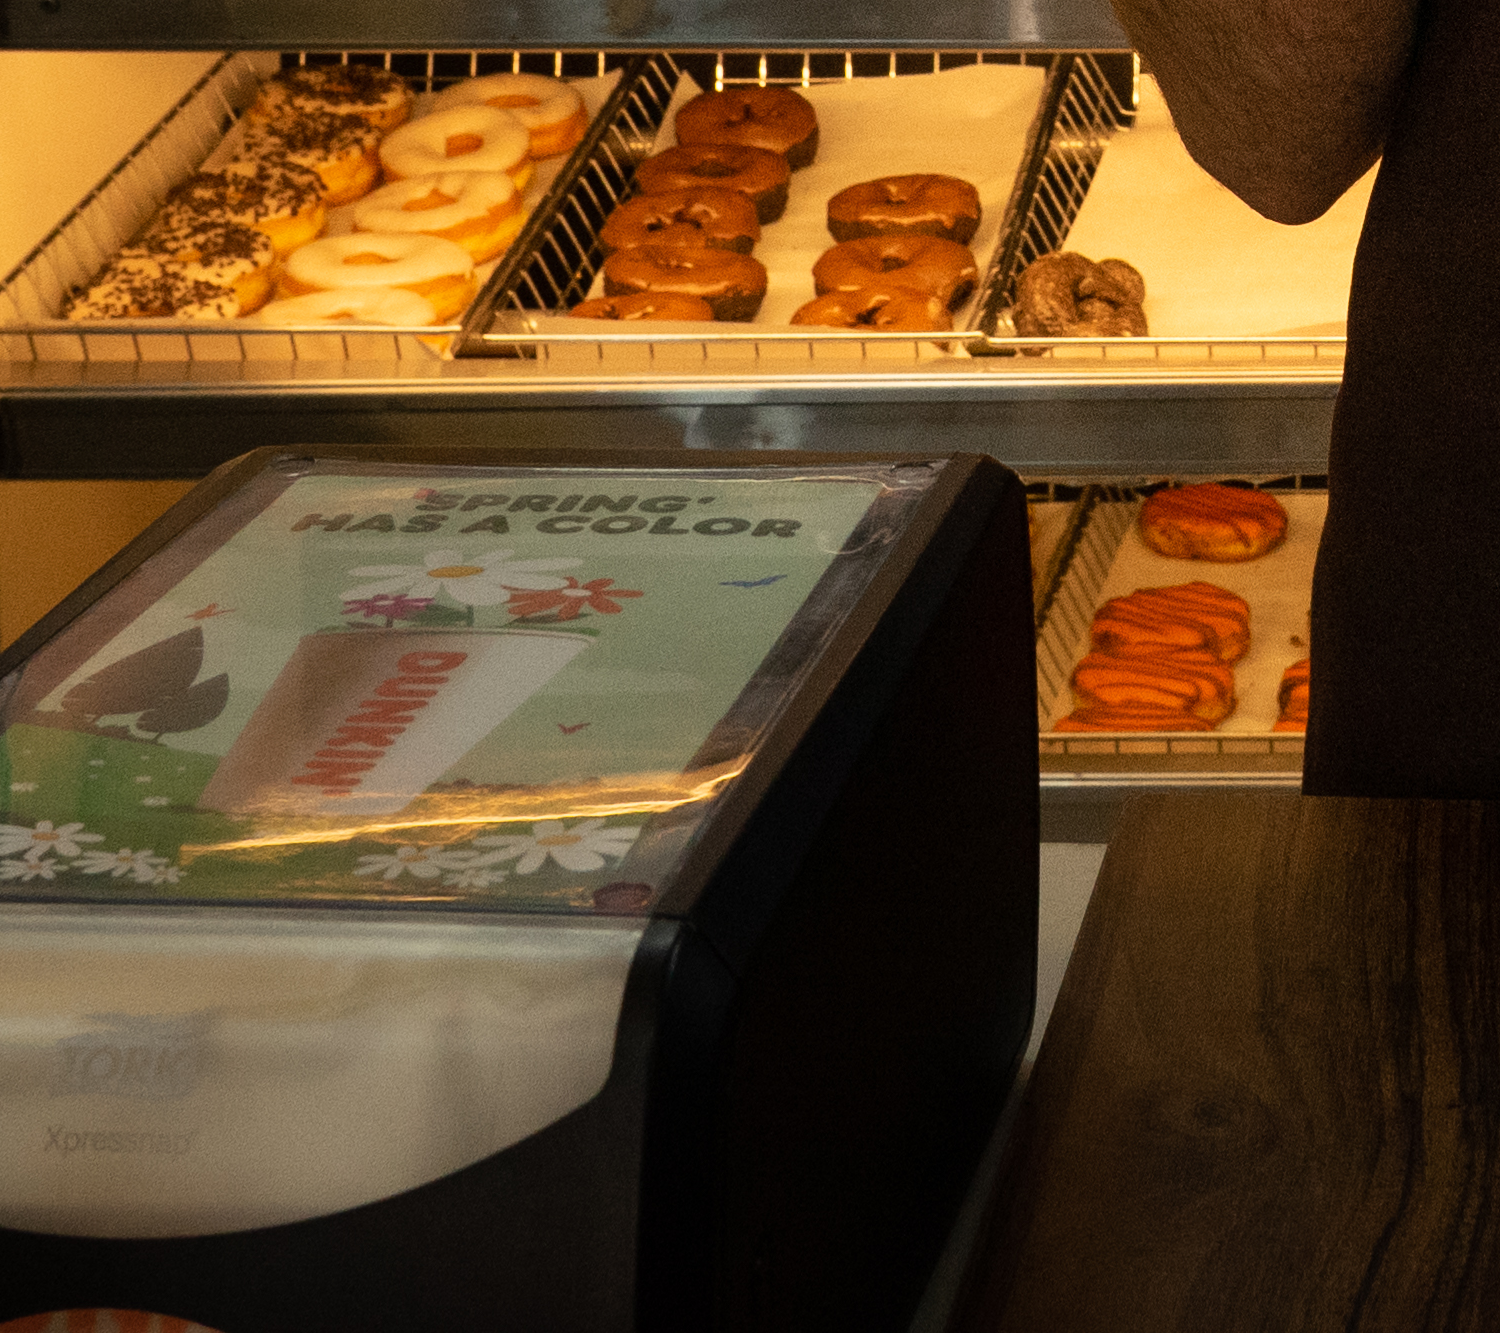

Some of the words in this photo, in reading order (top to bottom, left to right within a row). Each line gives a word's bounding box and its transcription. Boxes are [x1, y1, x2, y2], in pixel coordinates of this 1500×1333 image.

[290, 513, 449, 533] HAS
[460, 514, 511, 533] A
[535, 515, 803, 538] COLOR
